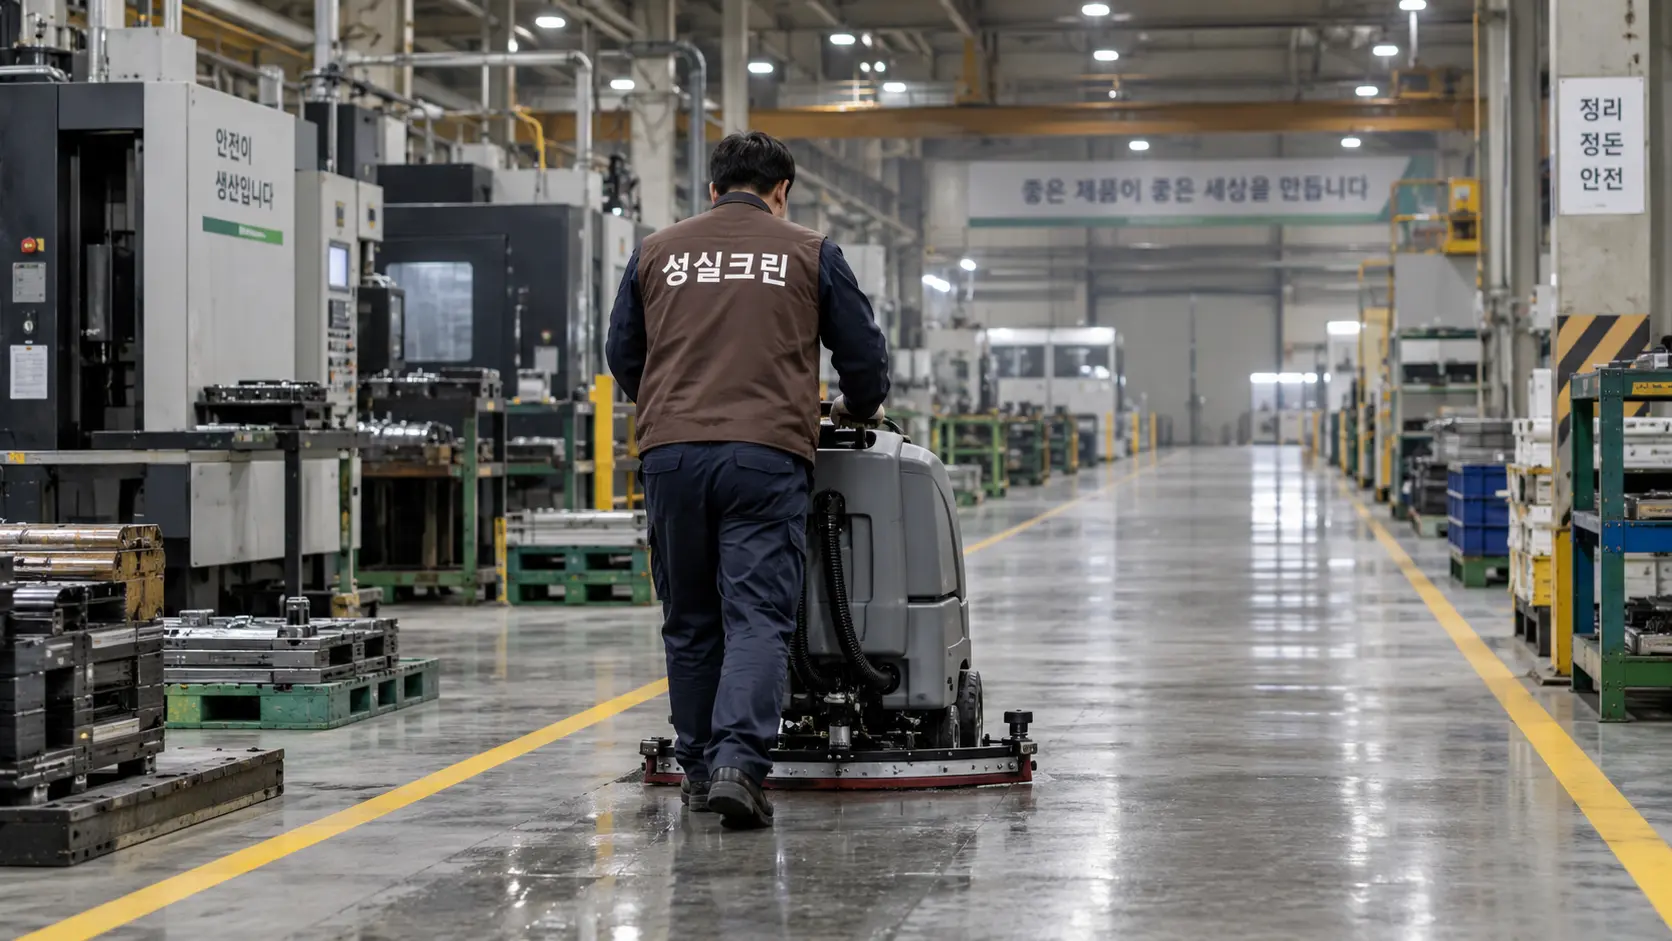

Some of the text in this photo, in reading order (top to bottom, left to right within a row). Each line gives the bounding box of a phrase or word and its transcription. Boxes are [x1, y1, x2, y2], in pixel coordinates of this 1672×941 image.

[1580, 97, 1622, 121] 정리
[215, 128, 252, 166] 안전이
[1580, 132, 1624, 157] 정돈
[215, 170, 274, 211] 생산입니다
[1022, 175, 1369, 205] 좋은 제품이 좋은 세상을 만듭니다
[1580, 167, 1623, 191] 안전
[661, 251, 788, 287] 성실크린
